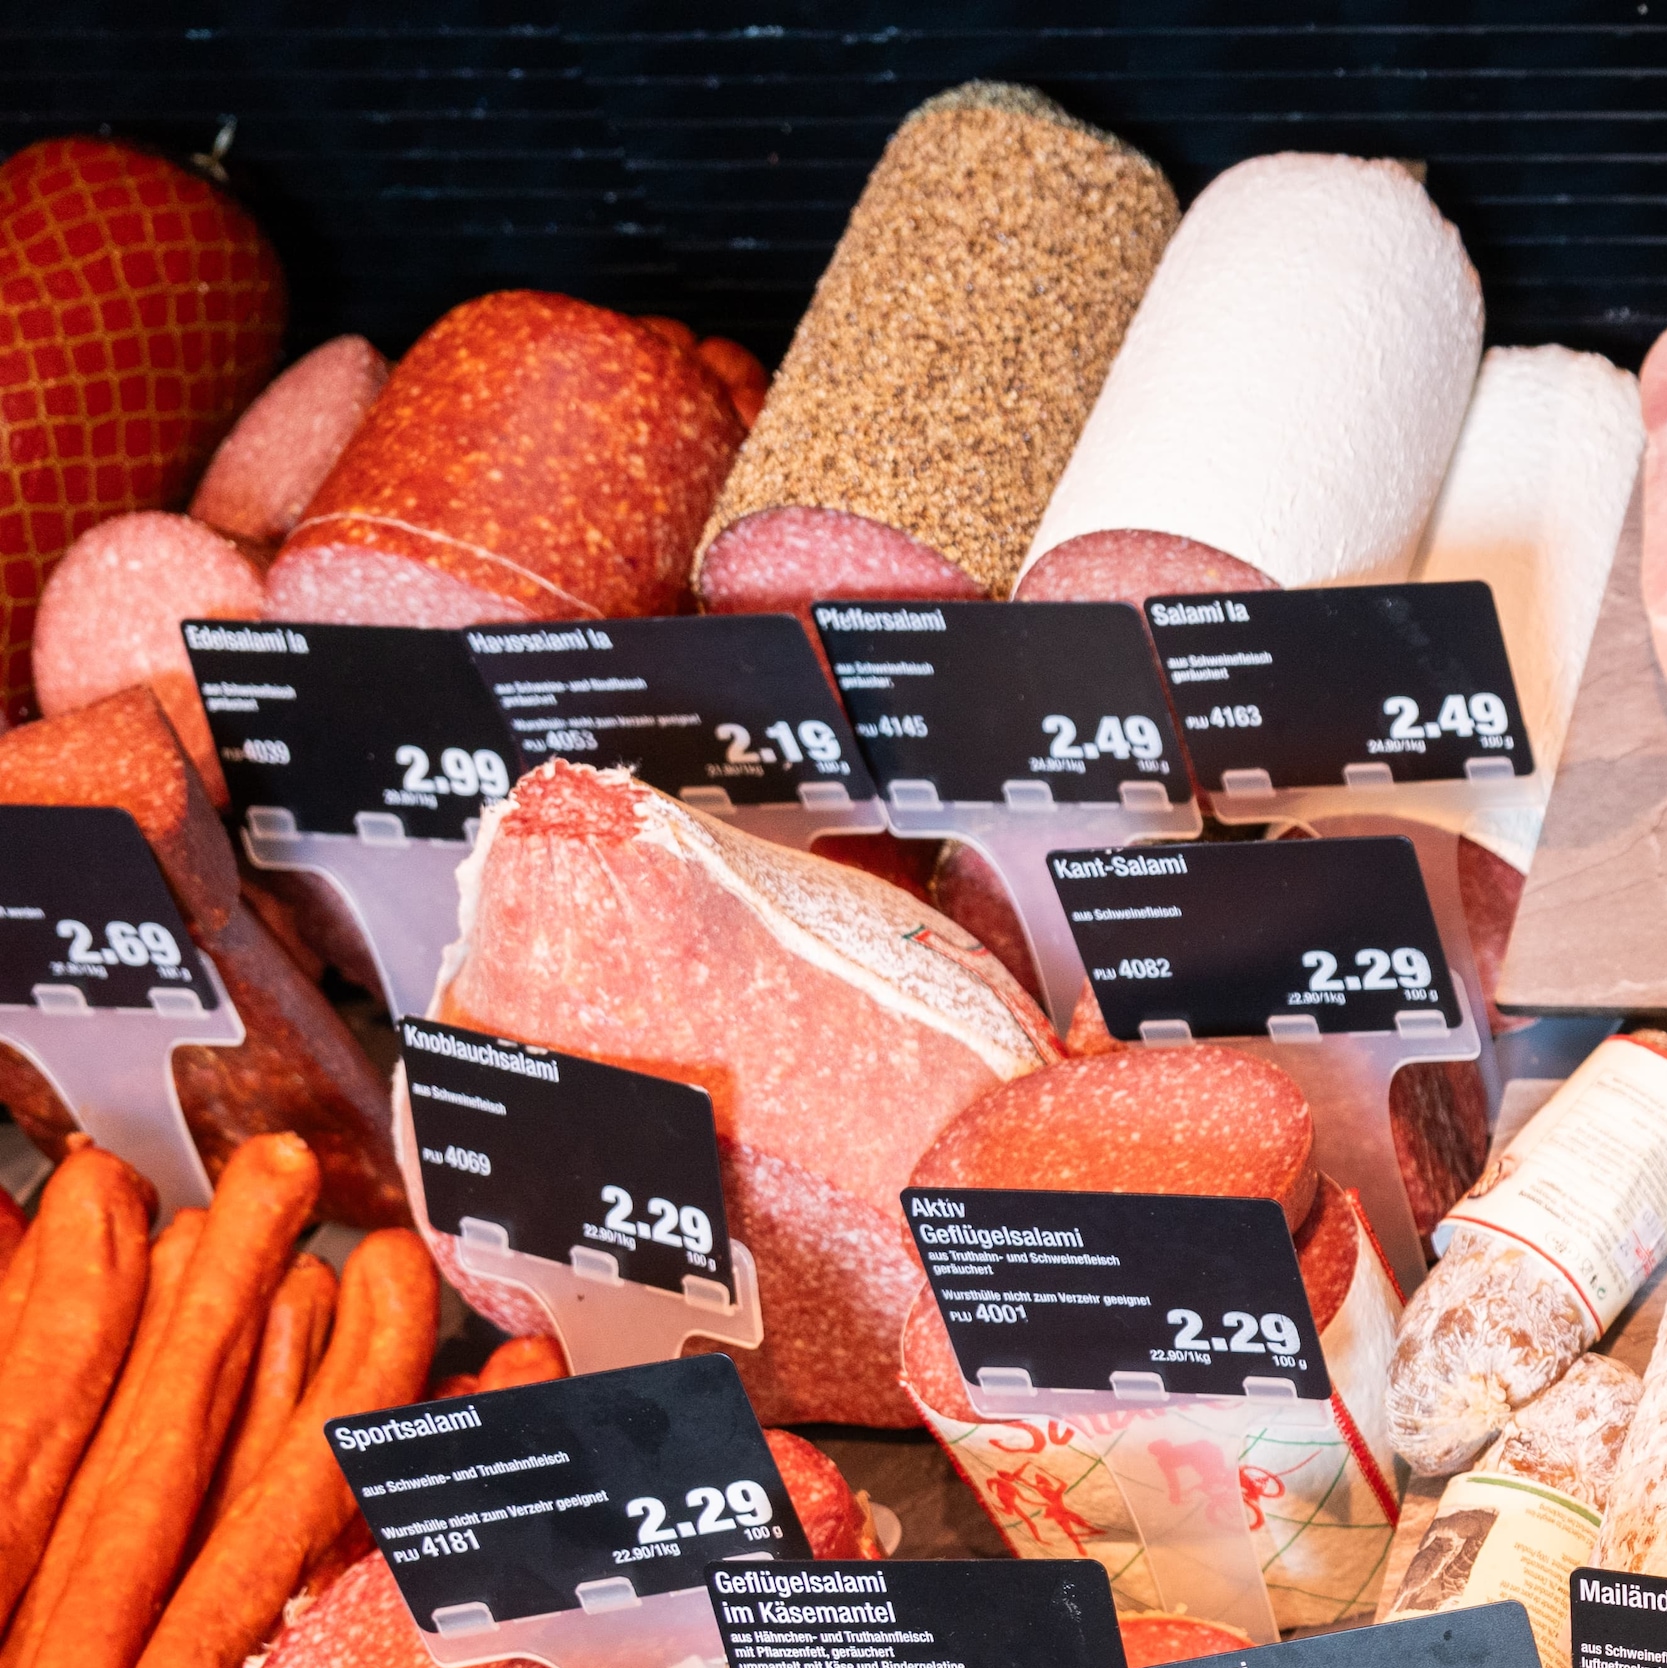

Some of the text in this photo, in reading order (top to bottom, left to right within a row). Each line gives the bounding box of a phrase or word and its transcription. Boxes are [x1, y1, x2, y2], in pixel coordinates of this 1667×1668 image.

[1150, 600, 1225, 626] Salami
[1042, 714, 1163, 761] 2.49
[1382, 692, 1509, 739] 2.49
[715, 720, 842, 764] 2.19
[396, 745, 509, 796] 2.99
[1053, 853, 1188, 879] Kant-Salami
[56, 919, 181, 966] 2.69
[1118, 958, 1173, 979] 4082
[1302, 948, 1432, 994] 2.29
[403, 1023, 560, 1083] Knoblauchsalami
[444, 1145, 492, 1176] 4069
[601, 1184, 713, 1253] 2.29
[911, 1197, 966, 1218] Aktiv
[919, 1223, 1084, 1250] Geflügelsalami
[975, 1303, 1027, 1324] 4001
[1167, 1307, 1301, 1355] 2.29
[334, 1404, 482, 1452] Sportsalami
[626, 1479, 773, 1545] 2.29
[422, 1528, 481, 1557] 4181
[714, 1570, 888, 1599] Geflügelsalami
[721, 1600, 897, 1624] im Käsemantel
